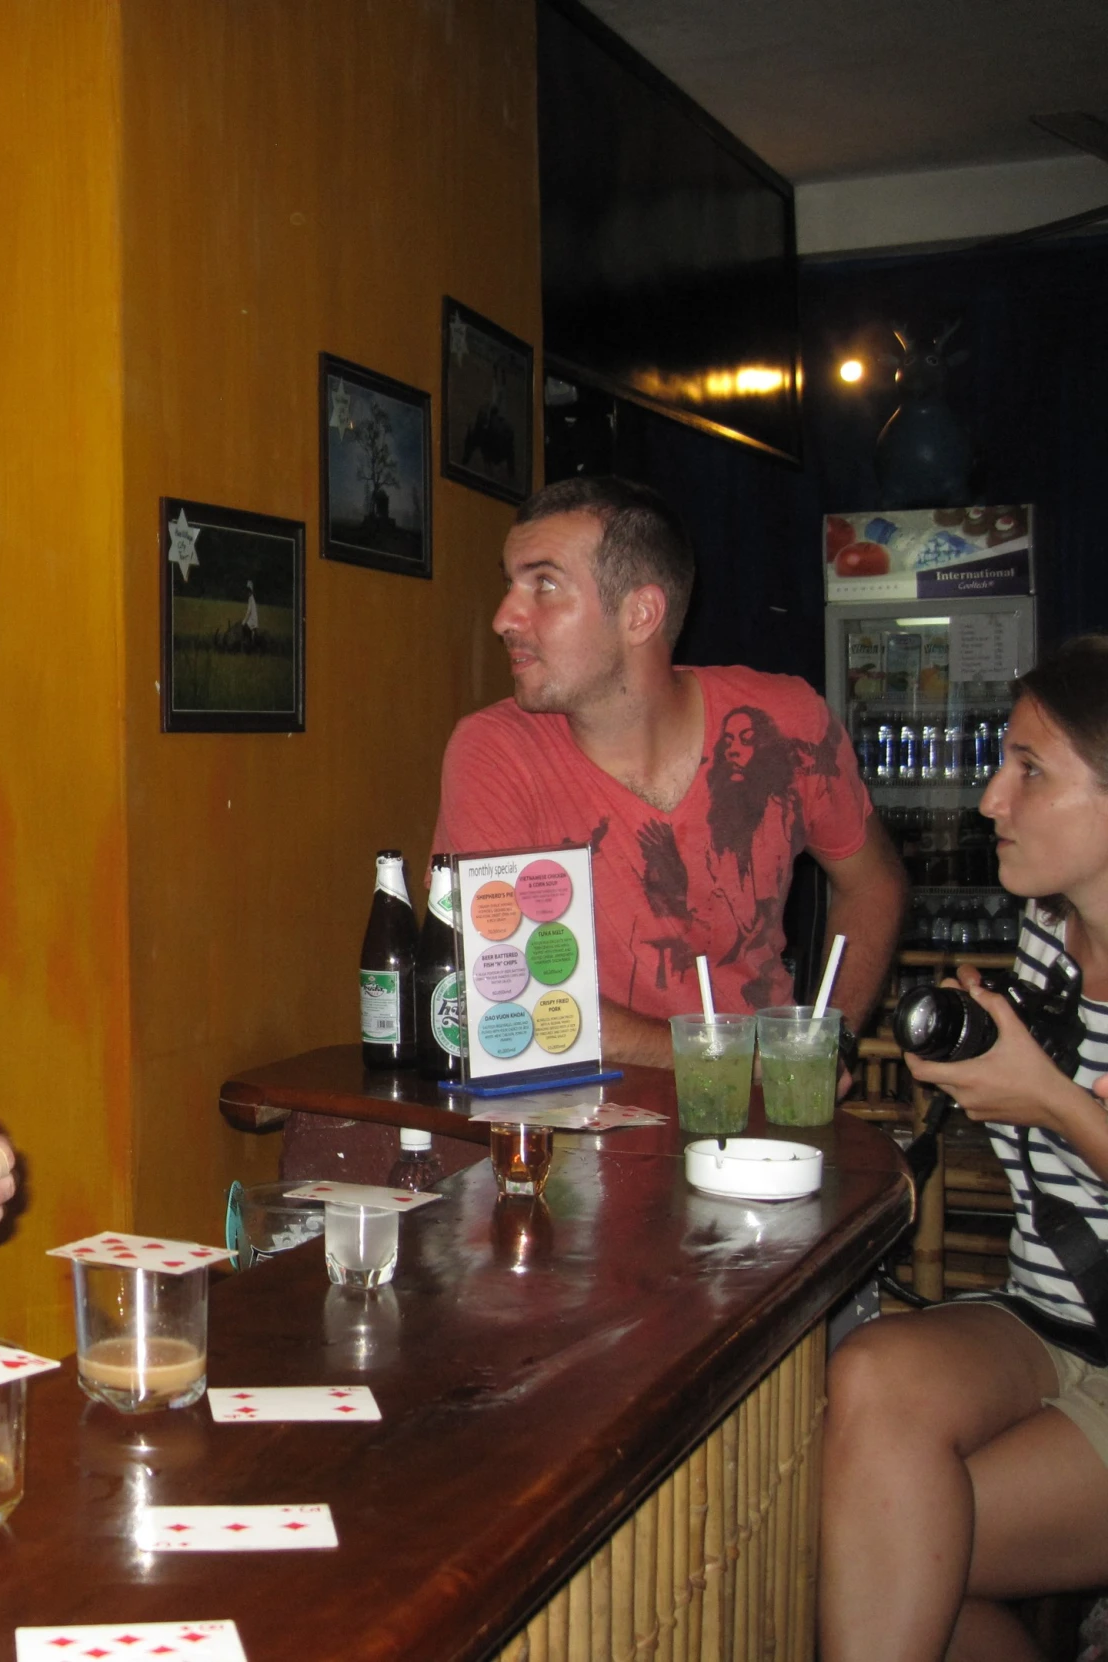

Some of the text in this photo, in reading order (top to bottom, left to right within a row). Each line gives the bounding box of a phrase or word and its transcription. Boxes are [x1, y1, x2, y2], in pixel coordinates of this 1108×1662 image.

[936, 568, 1015, 580] International
[468, 862, 518, 878] monthly specials
[476, 892, 506, 900] SHEPHERD'S
[494, 952, 518, 960] BATTERED
